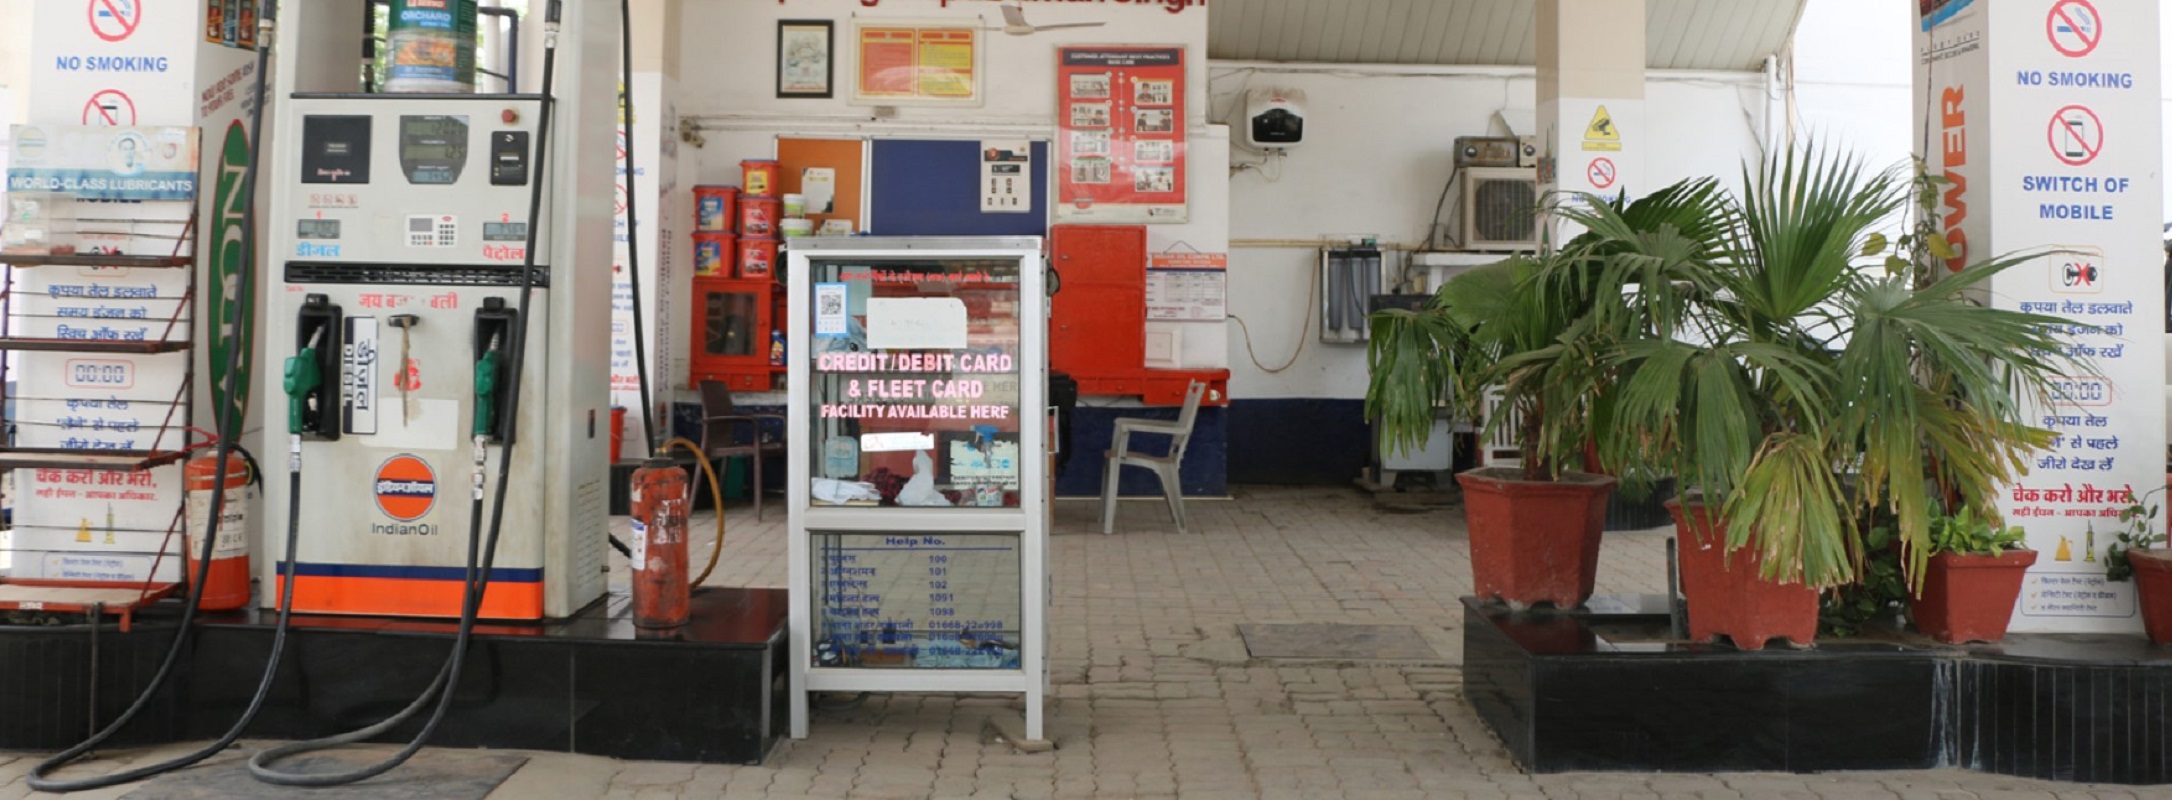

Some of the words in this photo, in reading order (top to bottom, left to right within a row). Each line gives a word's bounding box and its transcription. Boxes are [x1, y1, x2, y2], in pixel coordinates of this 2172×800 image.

[57, 57, 81, 71] NO
[86, 57, 168, 72] SMOKING
[2017, 71, 2042, 85] NO
[2048, 72, 2132, 88] SMOKING
[10, 177, 107, 190] WORLD-CLASS
[109, 179, 193, 192] LUBRICANTS
[1941, 84, 1967, 273] OWER
[2023, 176, 2097, 192] SWITCH
[2104, 178, 2129, 192] OF
[2040, 204, 2113, 219] MOBILE
[2061, 299, 2083, 314] तेल
[818, 353, 955, 372] CREDIT/DEBIT
[960, 353, 1012, 371] CARD
[848, 380, 861, 398] &
[868, 380, 926, 398] FLEET
[932, 380, 984, 398] CARD
[820, 405, 885, 418] FACILITY
[887, 405, 966, 418] AVAILABLE
[2085, 413, 2108, 427] तेल
[2071, 434, 2082, 449] से
[2086, 435, 2119, 450] पहले
[2037, 455, 2066, 469] जीरो
[2071, 457, 2095, 470] देख
[2012, 483, 2040, 502] चेक
[2043, 483, 2072, 503] करो
[2077, 483, 2104, 503] और
[372, 523, 438, 536] IndianOil
[886, 536, 918, 548] Help
[923, 536, 946, 545] No.
[929, 555, 947, 564] 100
[929, 567, 947, 576] 101
[929, 581, 947, 589] 102
[929, 593, 954, 602] 1091
